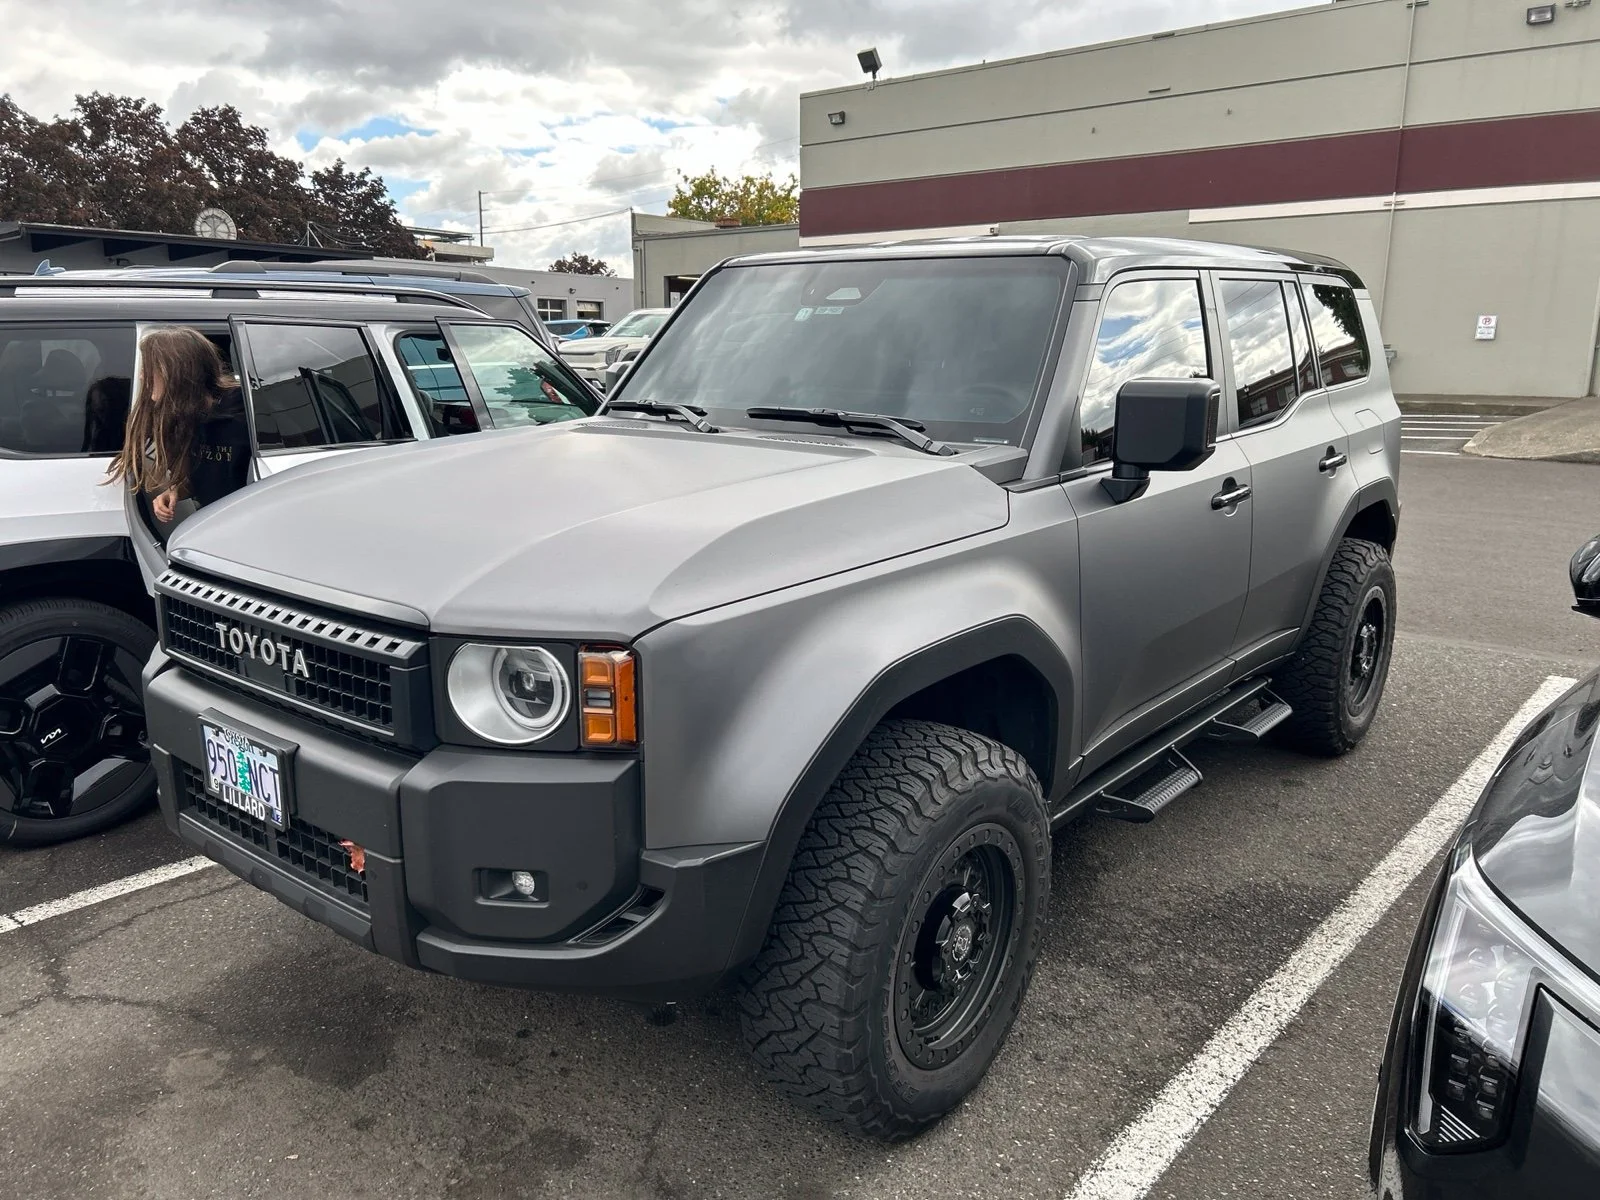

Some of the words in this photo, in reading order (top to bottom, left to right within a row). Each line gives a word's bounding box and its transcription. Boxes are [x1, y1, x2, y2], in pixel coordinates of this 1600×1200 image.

[215, 622, 310, 678] TOYOTA
[206, 738, 238, 787] 950
[247, 756, 280, 808] NCT
[223, 784, 266, 821] LILLARD
